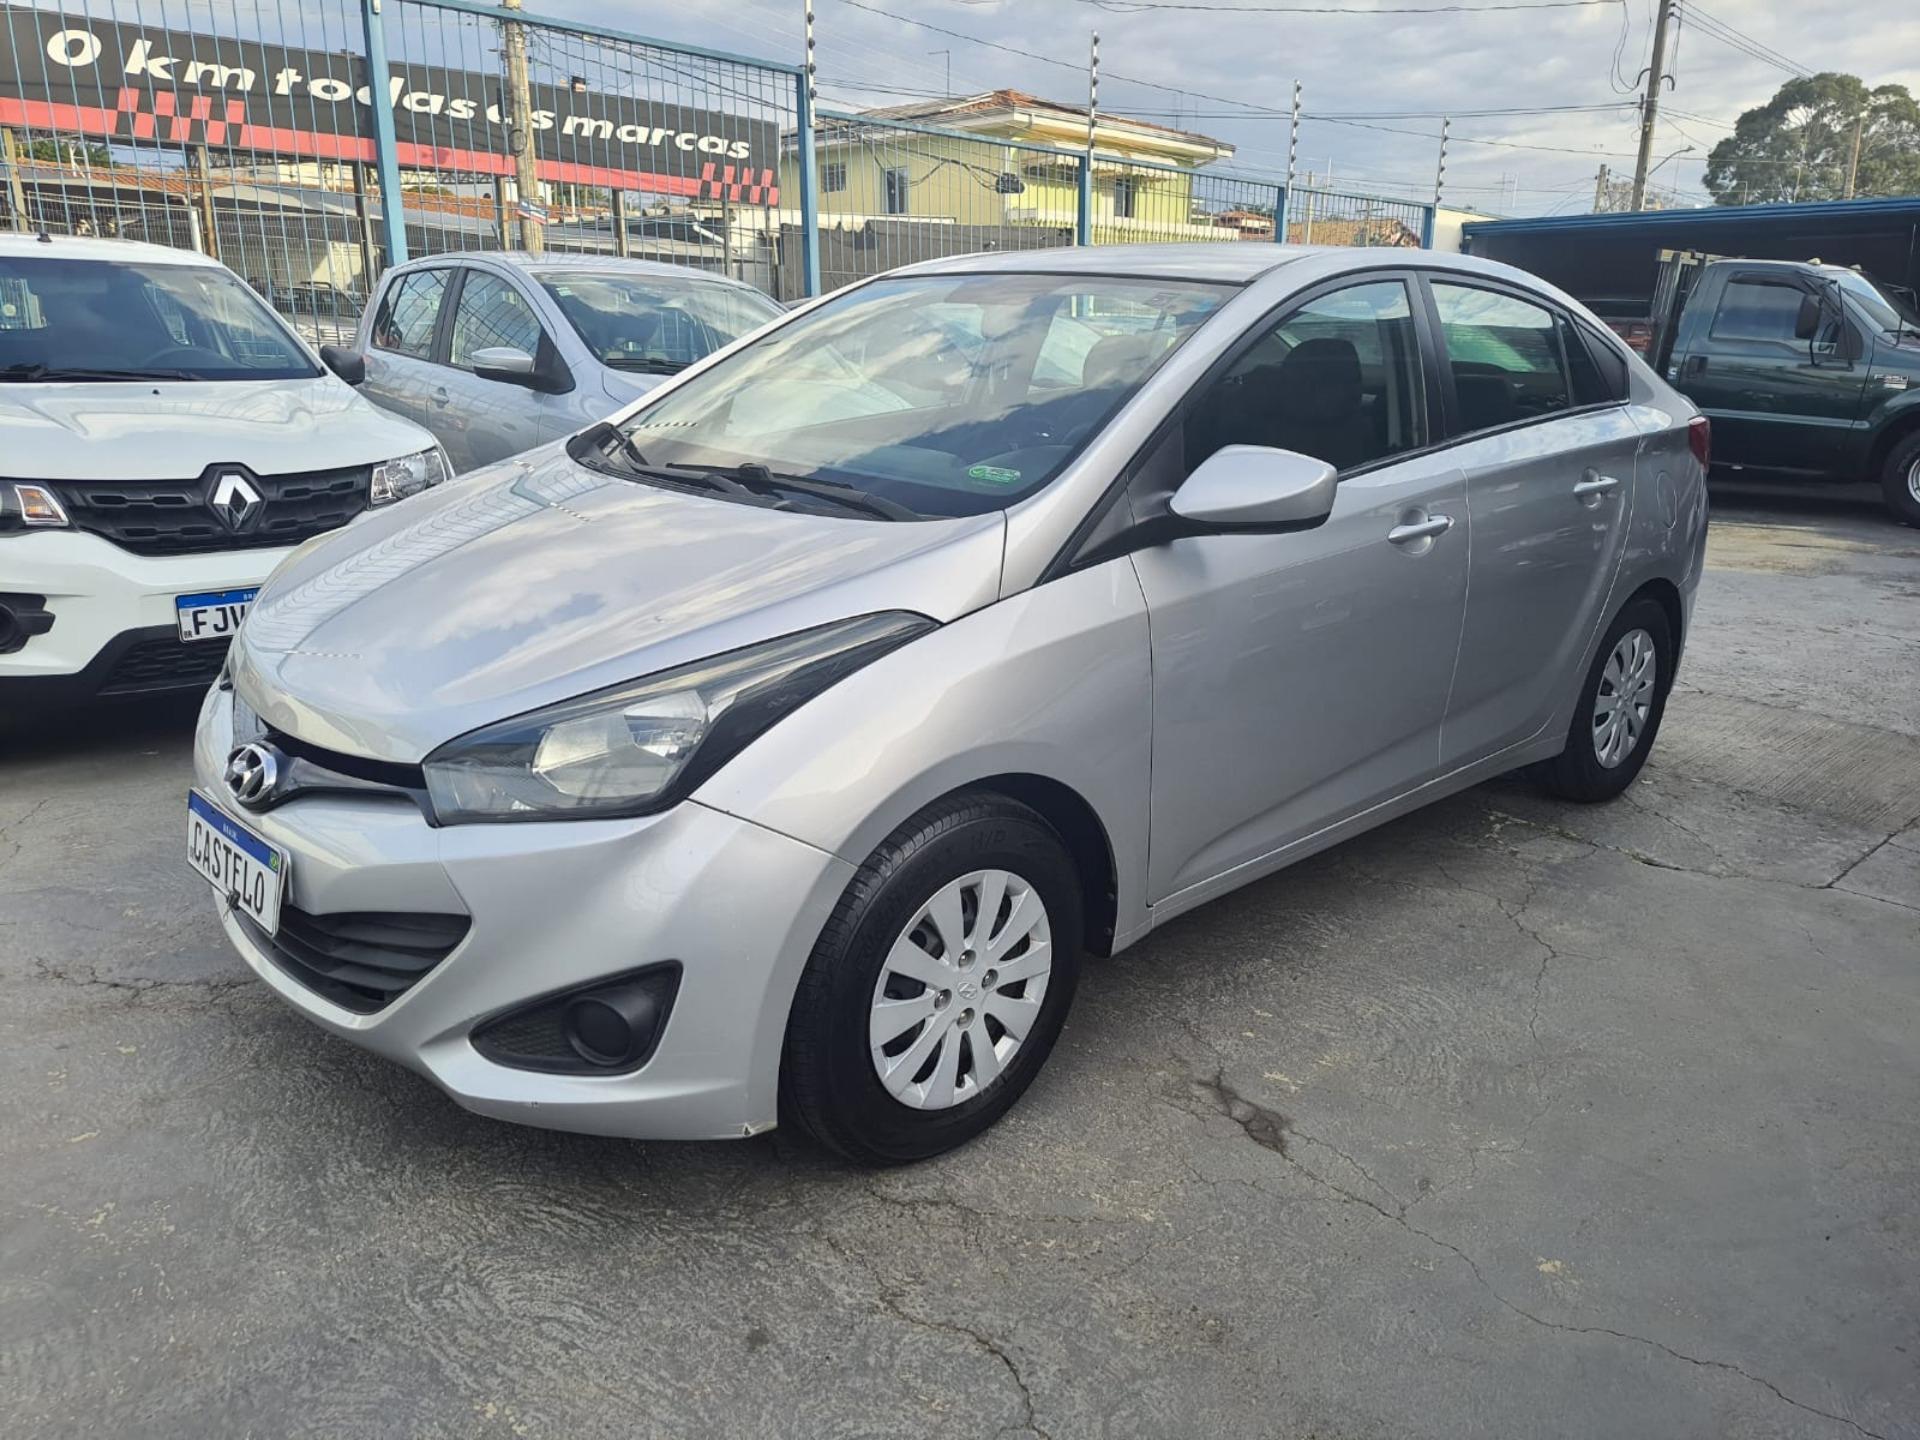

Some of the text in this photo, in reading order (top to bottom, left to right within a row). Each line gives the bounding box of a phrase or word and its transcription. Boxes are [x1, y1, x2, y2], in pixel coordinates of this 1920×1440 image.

[125, 39, 256, 91] km
[275, 68, 478, 120] todas
[562, 115, 751, 160] marcas
[192, 604, 246, 635] FJV
[193, 821, 265, 914] CASTELO
